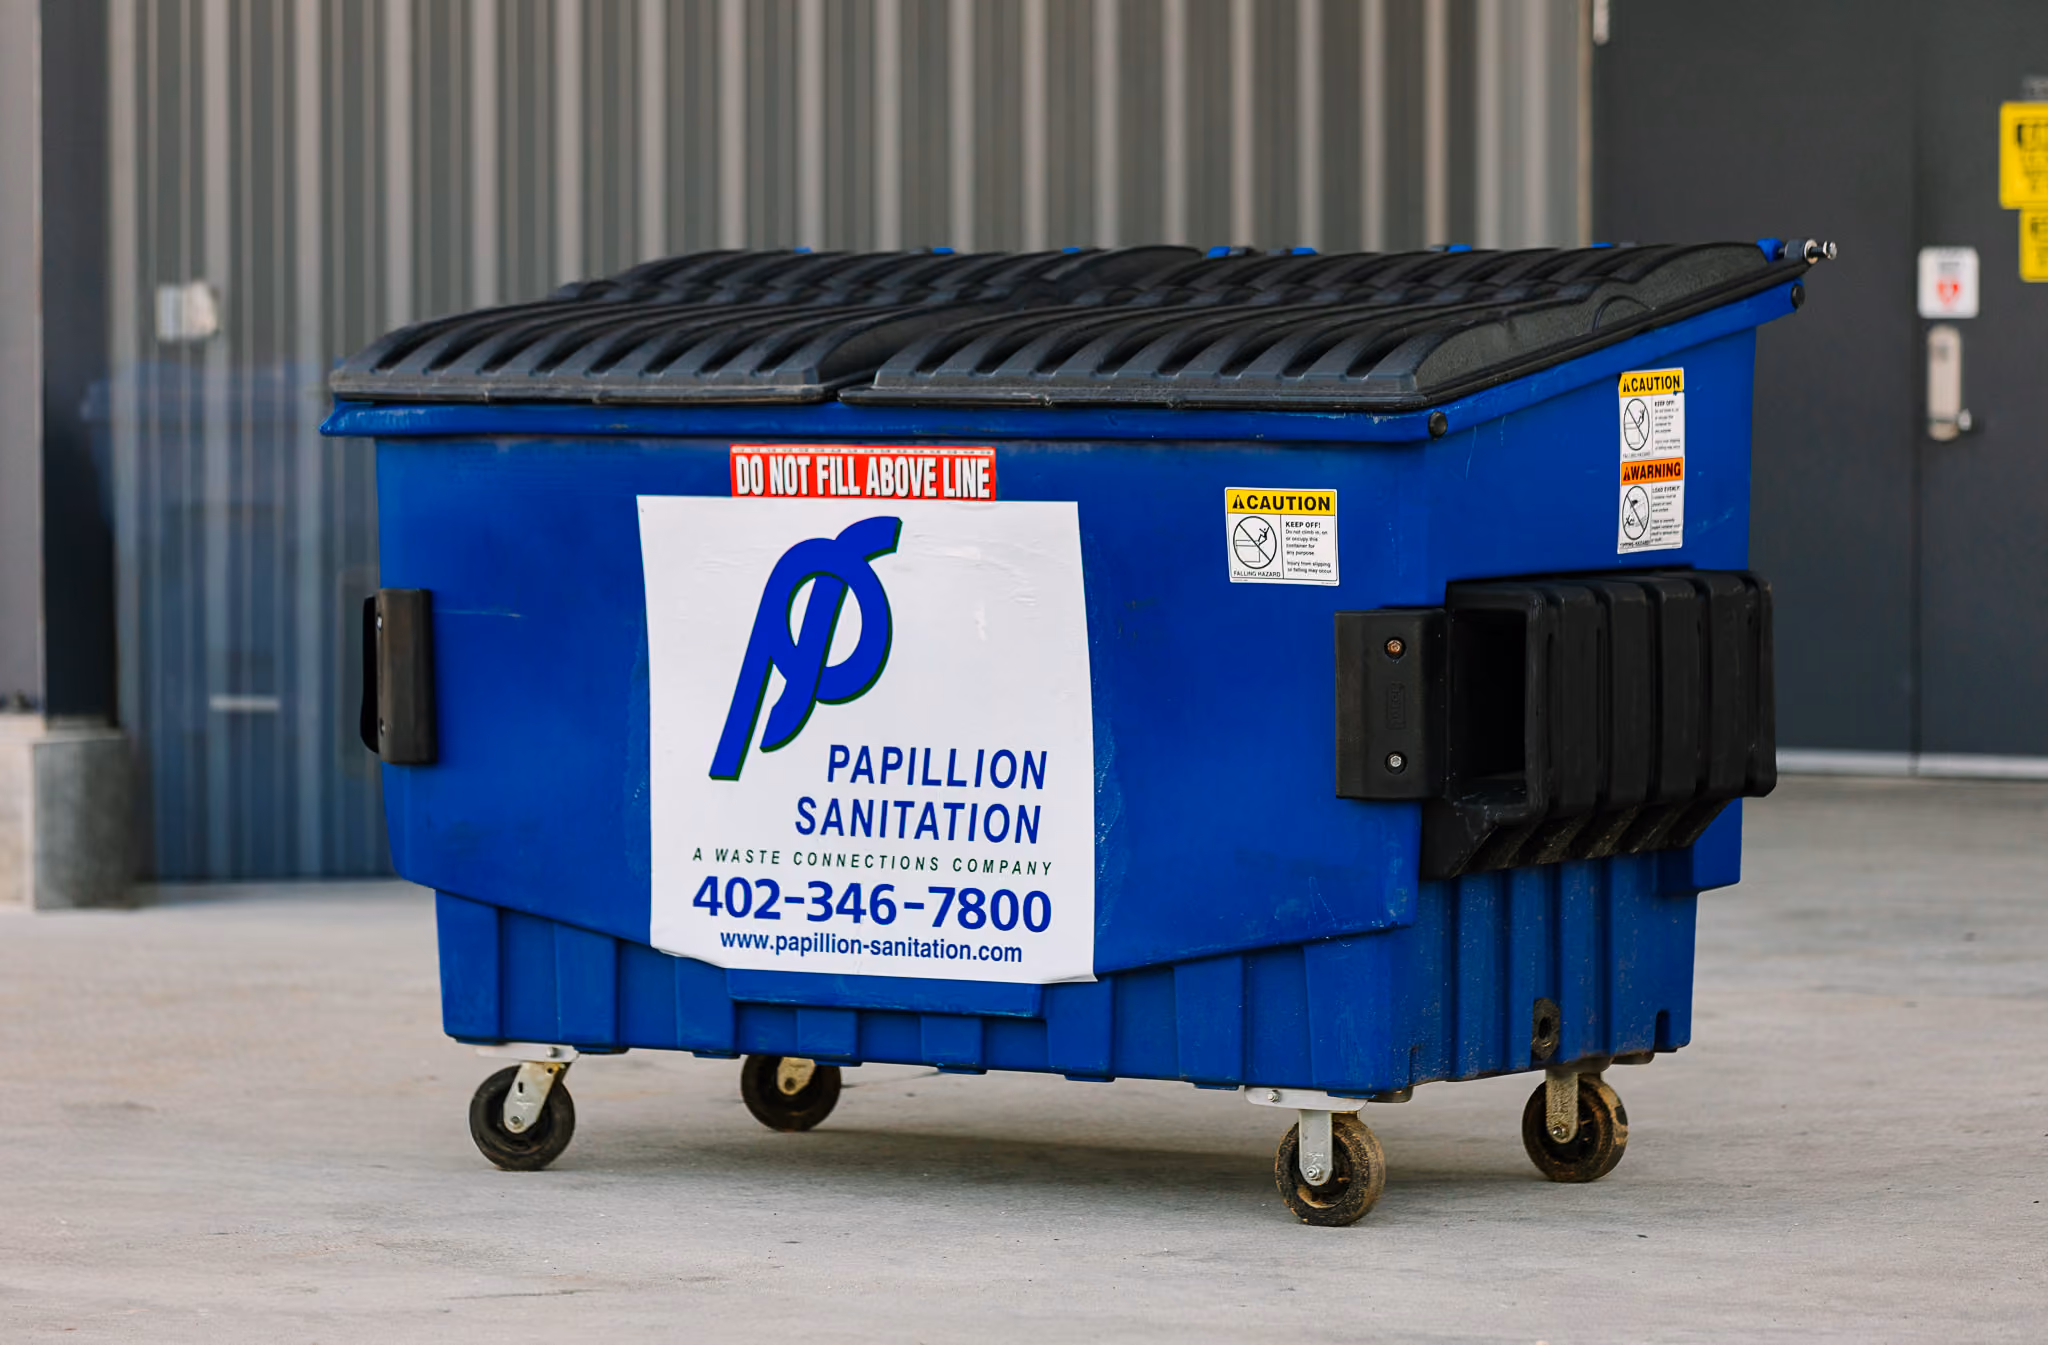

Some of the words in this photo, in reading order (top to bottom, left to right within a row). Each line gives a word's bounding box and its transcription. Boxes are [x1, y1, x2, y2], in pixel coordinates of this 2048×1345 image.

[1631, 374, 1680, 392] CAUTION
[735, 454, 765, 496] DO
[769, 455, 811, 496] NOT
[816, 455, 861, 497] FILL
[865, 456, 937, 497] ABOVE
[943, 456, 991, 499] LINE
[1630, 462, 1681, 481] WARNING
[1246, 494, 1330, 511] CAUTION
[1305, 521, 1321, 529] OFF!
[827, 744, 1048, 790] PAPILLION
[795, 796, 1041, 844] SANITATION
[692, 847, 703, 861] A
[715, 848, 780, 865] WASTE
[793, 851, 939, 872] CONNECTIONS
[952, 857, 1052, 876] COMPANY
[692, 875, 1052, 933] 402-346-7800
[720, 932, 1022, 963] www.papillion-sanitation.com
